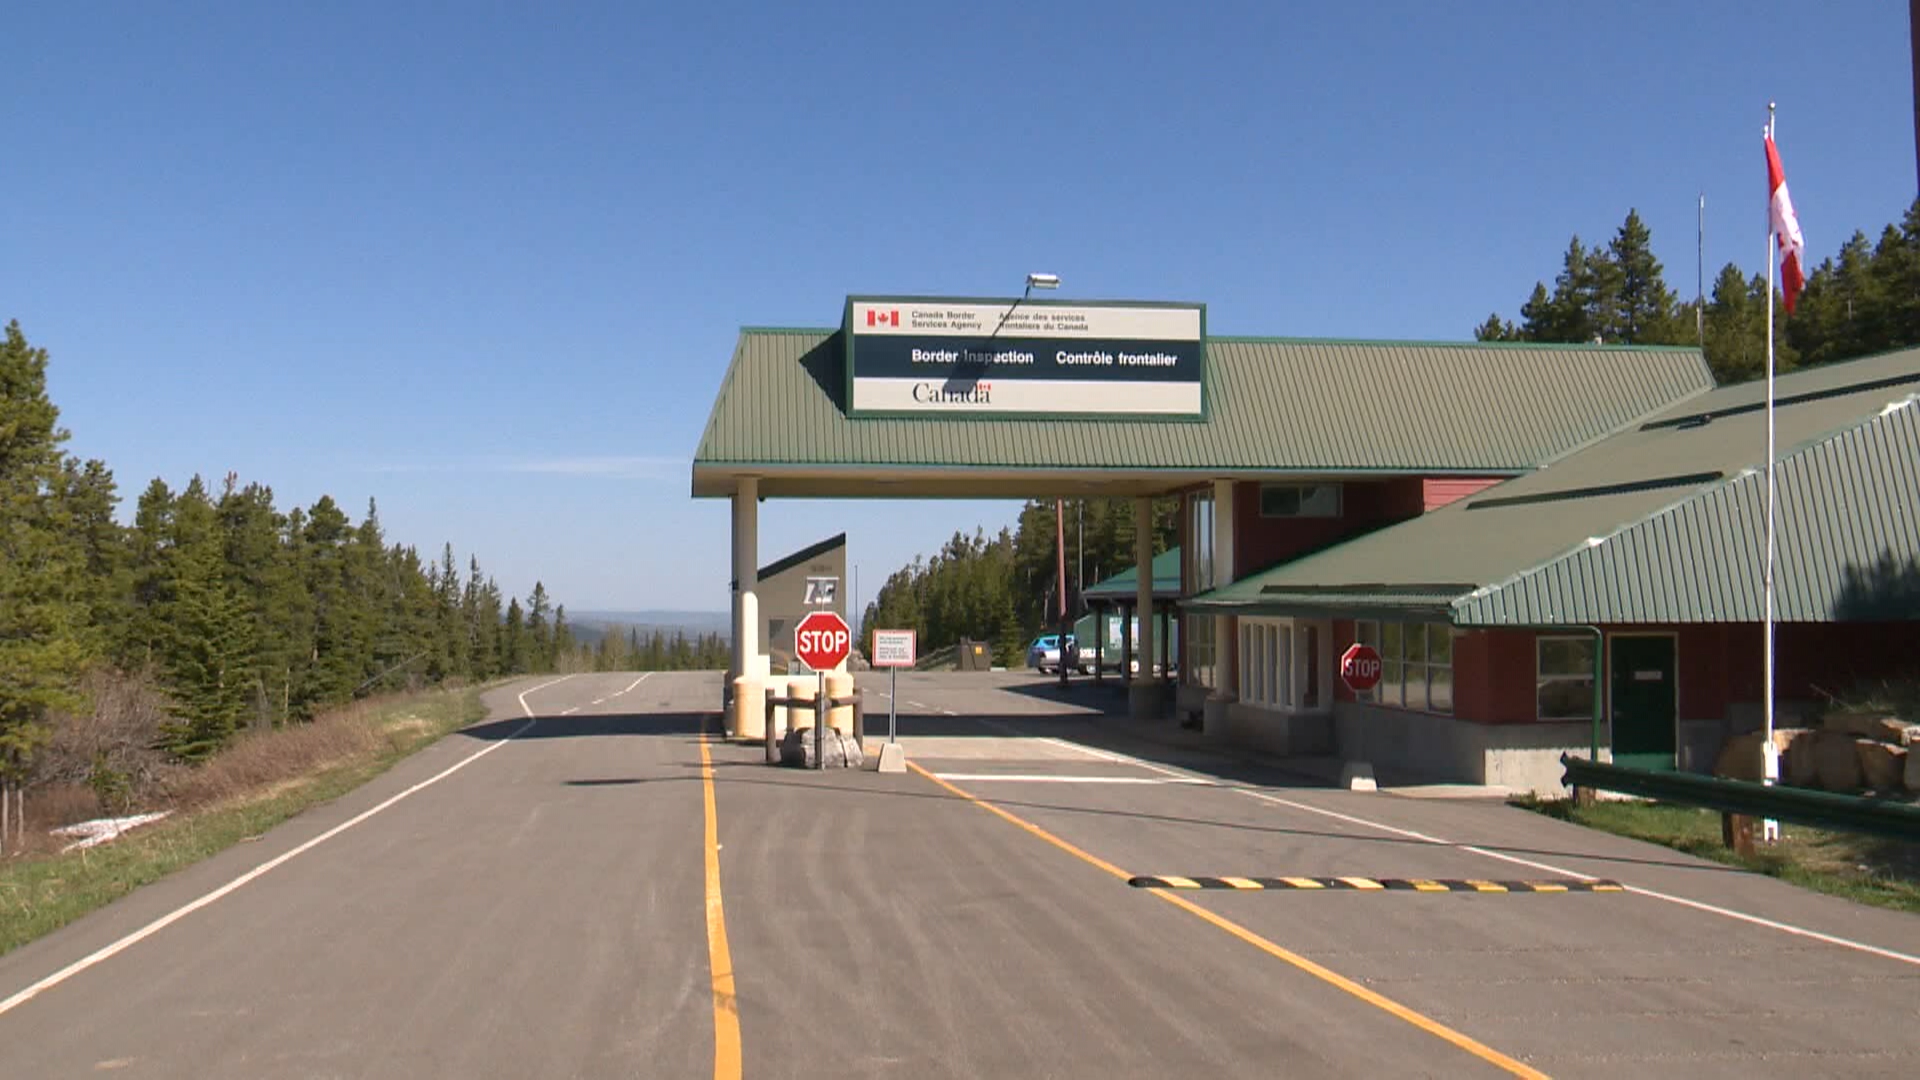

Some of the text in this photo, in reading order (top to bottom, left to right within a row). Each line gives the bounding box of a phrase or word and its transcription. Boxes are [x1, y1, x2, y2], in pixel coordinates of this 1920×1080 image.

[912, 310, 975, 319] Canada Border
[1033, 313, 1048, 321] des
[1051, 314, 1085, 322] services
[911, 320, 982, 331] Services Agency
[1044, 322, 1054, 330] du
[1058, 323, 1089, 331] Canada
[912, 349, 1034, 365] Border Inspection
[1055, 350, 1178, 366] Contrôle frontalier
[912, 383, 991, 404] Canada
[800, 630, 847, 654] STOP
[1345, 658, 1380, 678] STOP
